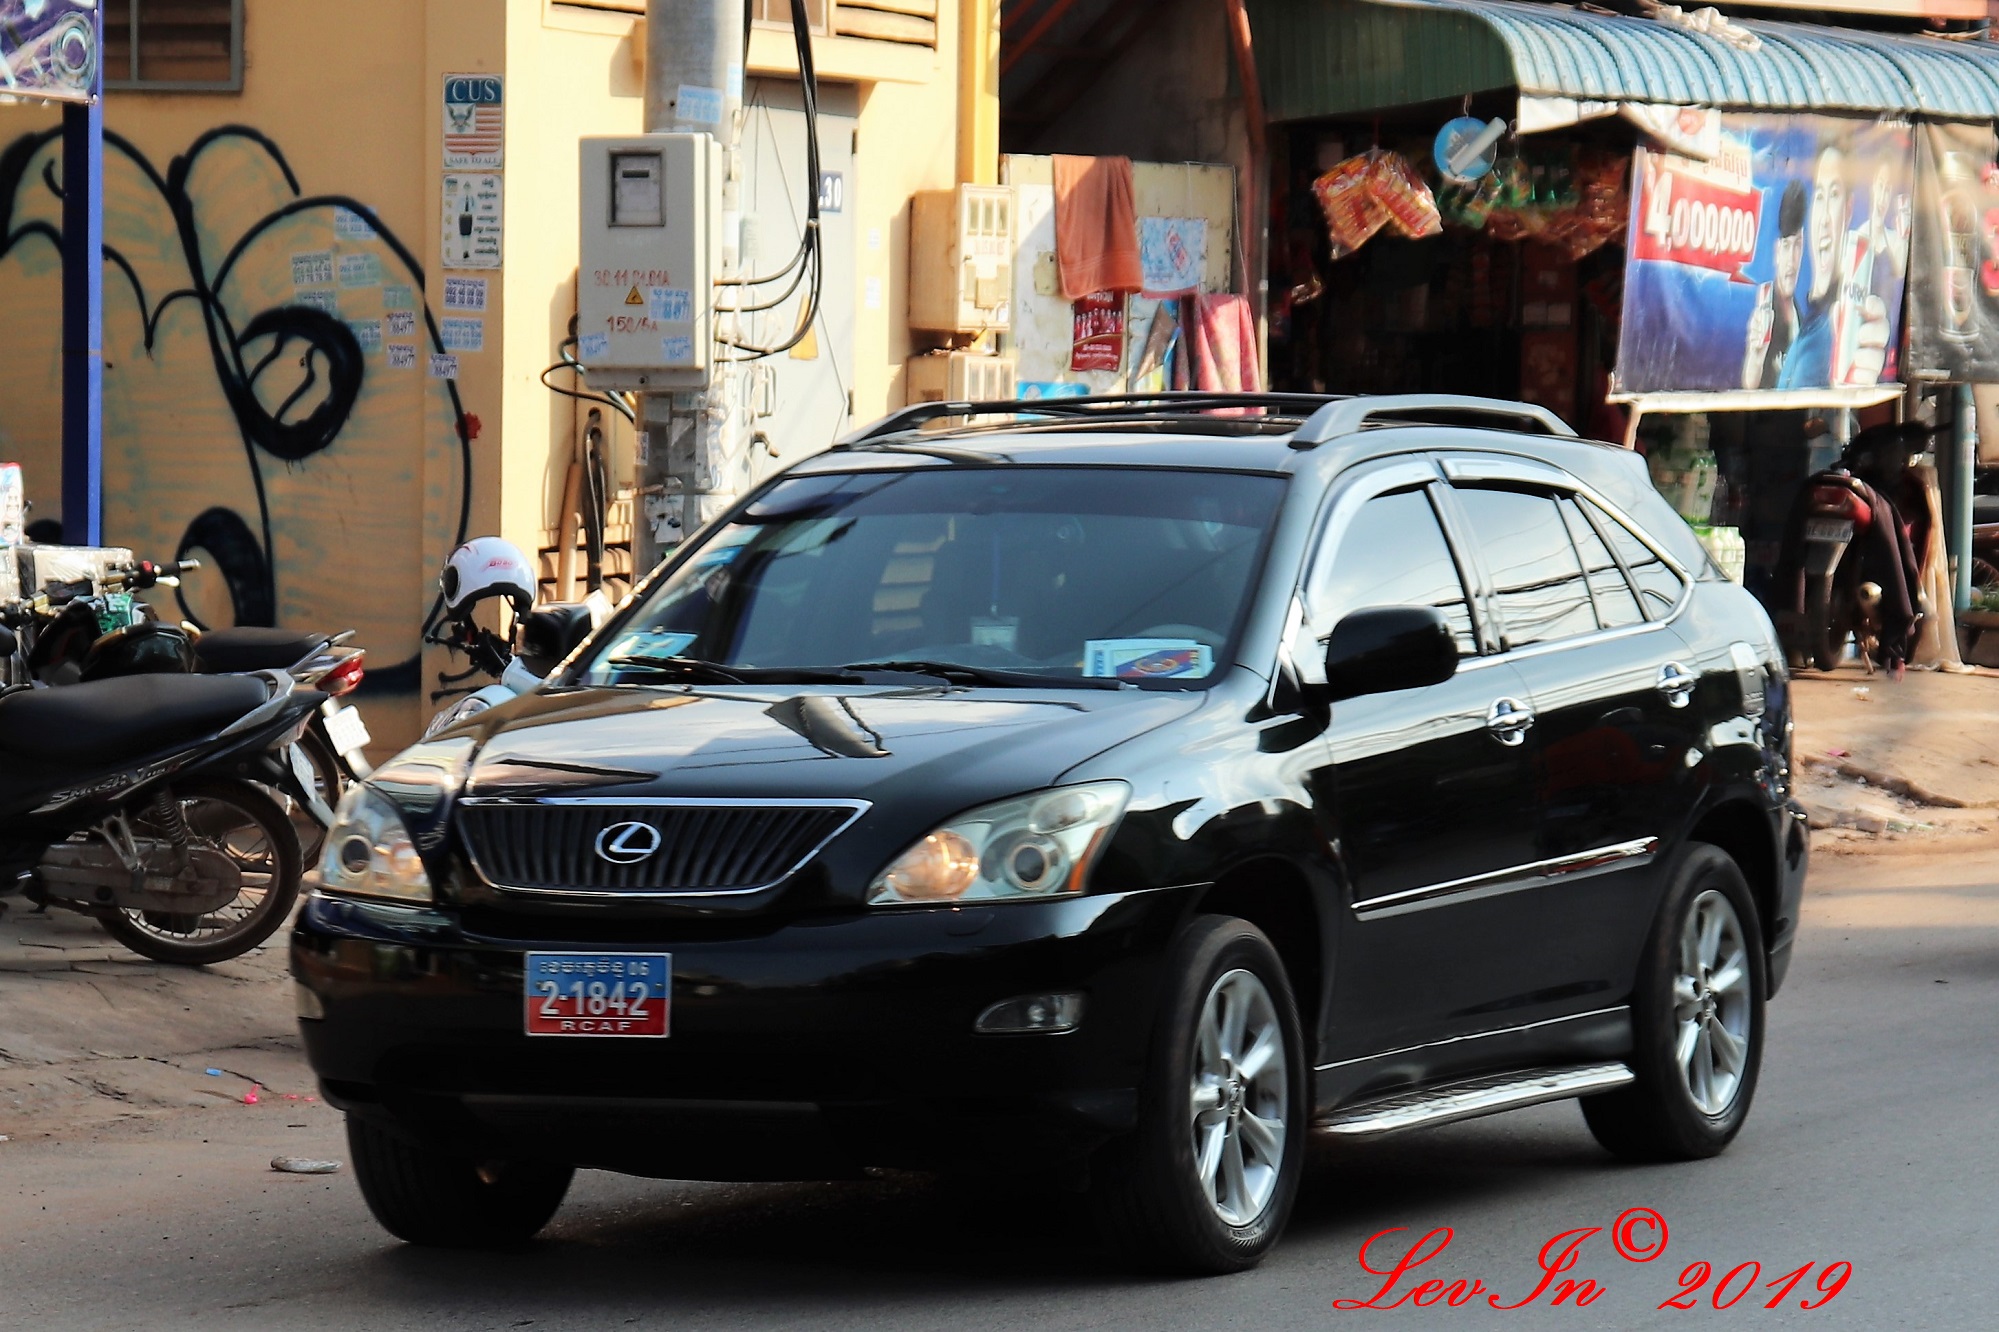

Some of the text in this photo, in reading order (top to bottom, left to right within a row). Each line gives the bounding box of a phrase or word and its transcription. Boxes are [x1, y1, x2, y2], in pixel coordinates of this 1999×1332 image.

[452, 79, 495, 102] CUS
[449, 156, 469, 165] SAFE
[471, 156, 482, 164] TO
[1645, 171, 1756, 256] 4,000,000
[627, 961, 650, 976] 06
[539, 980, 650, 1017] 2-1842
[559, 1020, 632, 1032] RCAF
